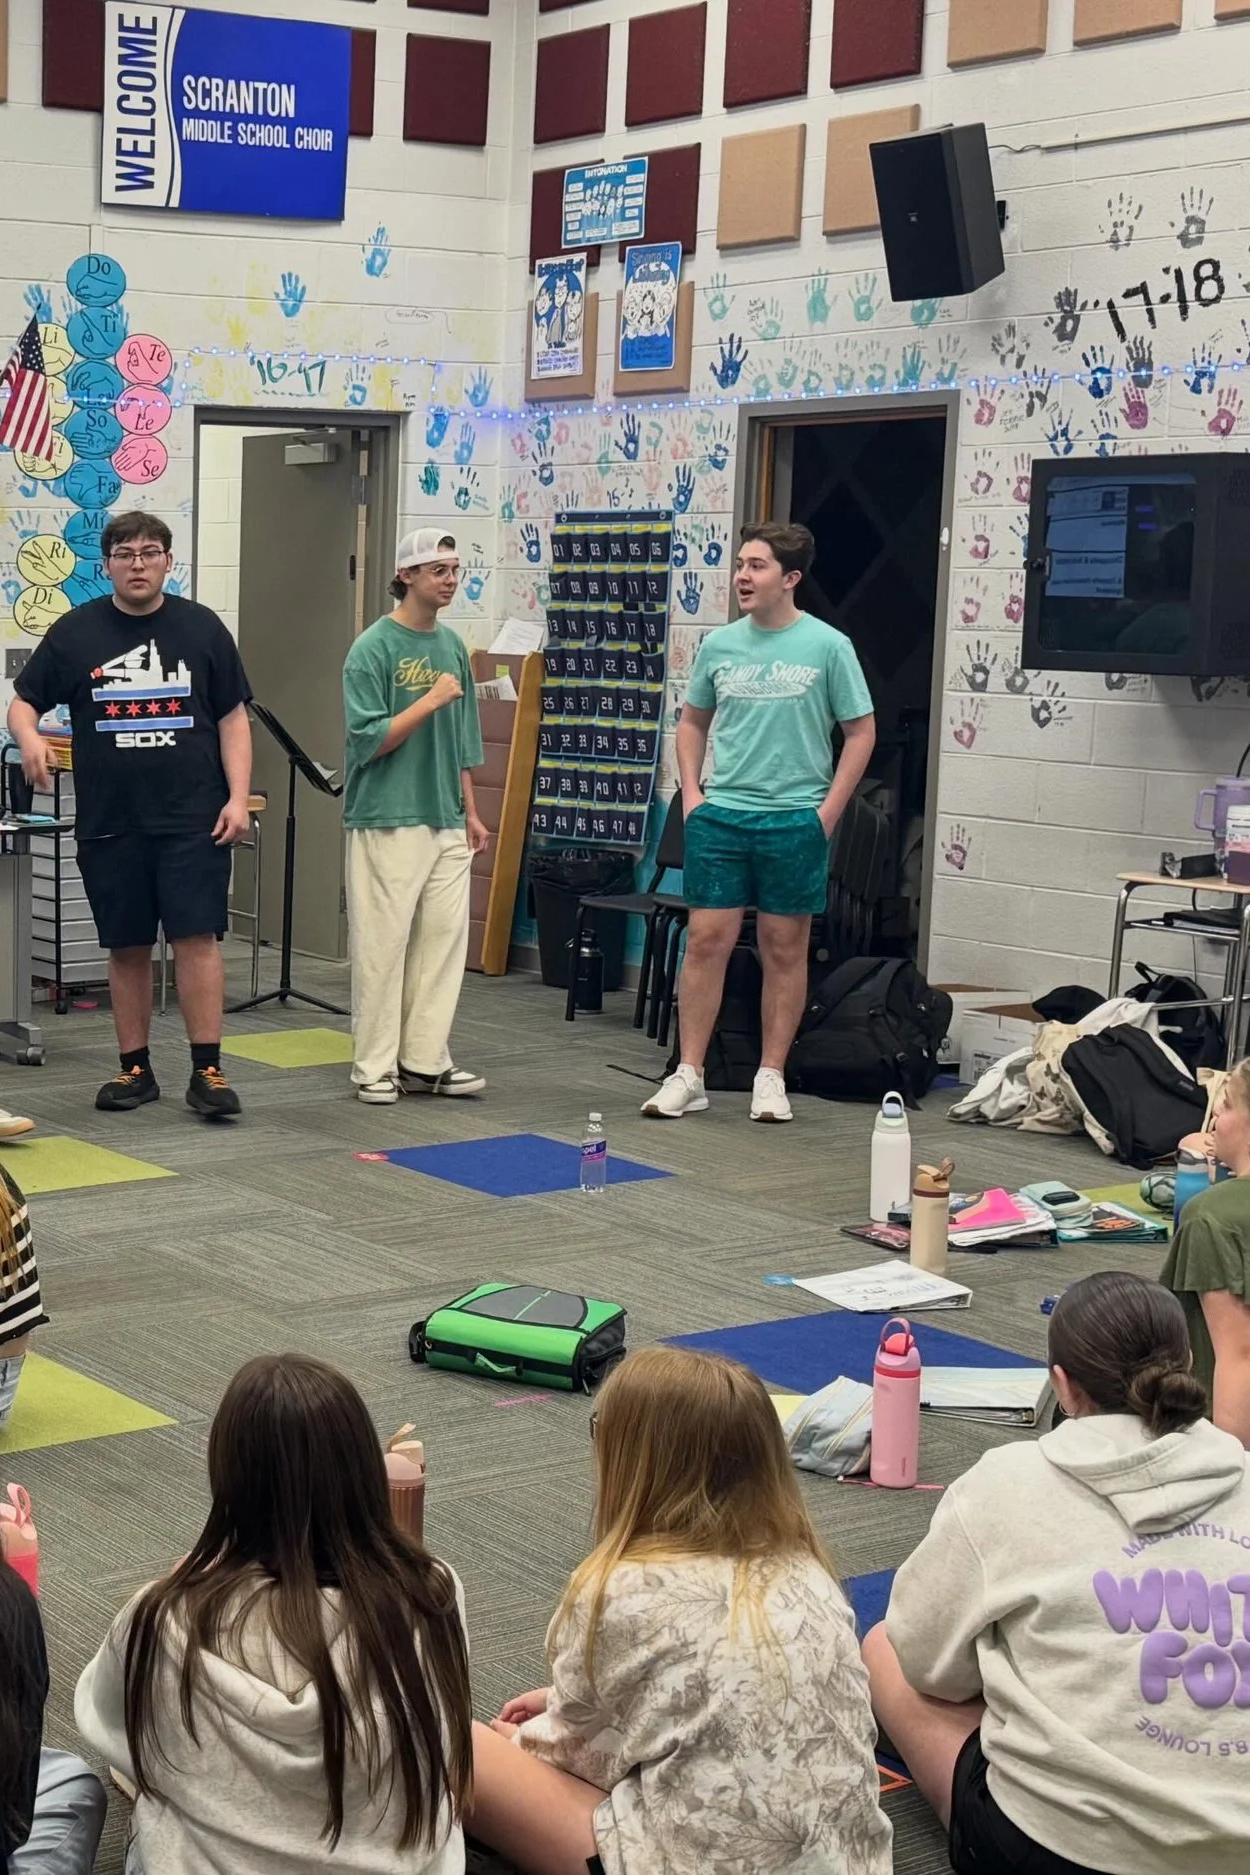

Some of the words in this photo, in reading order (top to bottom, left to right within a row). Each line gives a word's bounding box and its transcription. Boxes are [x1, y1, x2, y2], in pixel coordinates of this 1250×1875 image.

[115, 13, 158, 192] WELCOME
[182, 74, 296, 118] SCRANTON
[182, 118, 232, 144] MIDDLE
[237, 122, 290, 148] SCHOOL
[294, 128, 333, 151] CHOIR
[87, 256, 111, 275] Do
[101, 314, 118, 333] Ti
[43, 327, 58, 345] Li
[149, 345, 166, 362] Te
[87, 409, 107, 428] So
[135, 414, 154, 431] Le
[141, 461, 160, 478] Se
[97, 475, 121, 494] Fa
[83, 511, 106, 529] Mi
[50, 541, 66, 559] Ri
[552, 544, 564, 556] 01
[572, 543, 582, 556] 02
[590, 543, 600, 555] 03
[610, 543, 621, 556] 04
[630, 543, 641, 555] 05
[651, 542, 661, 555] 06
[33, 587, 53, 605] Di
[551, 582, 560, 594] 07
[571, 581, 581, 593] 08
[588, 582, 599, 594] 09
[608, 582, 618, 595] 10
[628, 581, 639, 595] 11
[647, 582, 658, 594] 12
[548, 620, 558, 632] 13
[567, 620, 577, 632] 14
[586, 621, 596, 633] 15
[606, 622, 617, 634] 16
[626, 622, 636, 635] 17
[645, 623, 655, 636] 18
[546, 658, 557, 671] 19
[566, 659, 575, 671] 20
[584, 660, 594, 671] 21
[605, 659, 617, 672] 22
[626, 660, 637, 673] 23
[543, 697, 555, 709] 25
[564, 697, 574, 710] 26
[580, 697, 589, 710] 27
[602, 697, 613, 710] 28
[622, 699, 634, 712] 29
[115, 731, 177, 748] SOX
[541, 733, 552, 746] 31
[561, 734, 571, 746] 32
[579, 734, 587, 747] 33
[597, 735, 609, 749] 34
[618, 738, 628, 751] 35
[637, 739, 646, 752] 36
[540, 777, 550, 790] 37
[561, 778, 571, 791] 38
[579, 780, 588, 793] 39
[597, 782, 609, 795] 40
[618, 782, 627, 795] 41
[533, 814, 546, 827] 43
[555, 815, 566, 829] 44
[577, 818, 586, 831] 45
[593, 819, 604, 832] 46
[613, 821, 622, 834] 47
[1178, 1521, 1225, 1541] WITH
[1134, 1715, 1212, 1757] LOUNGE
